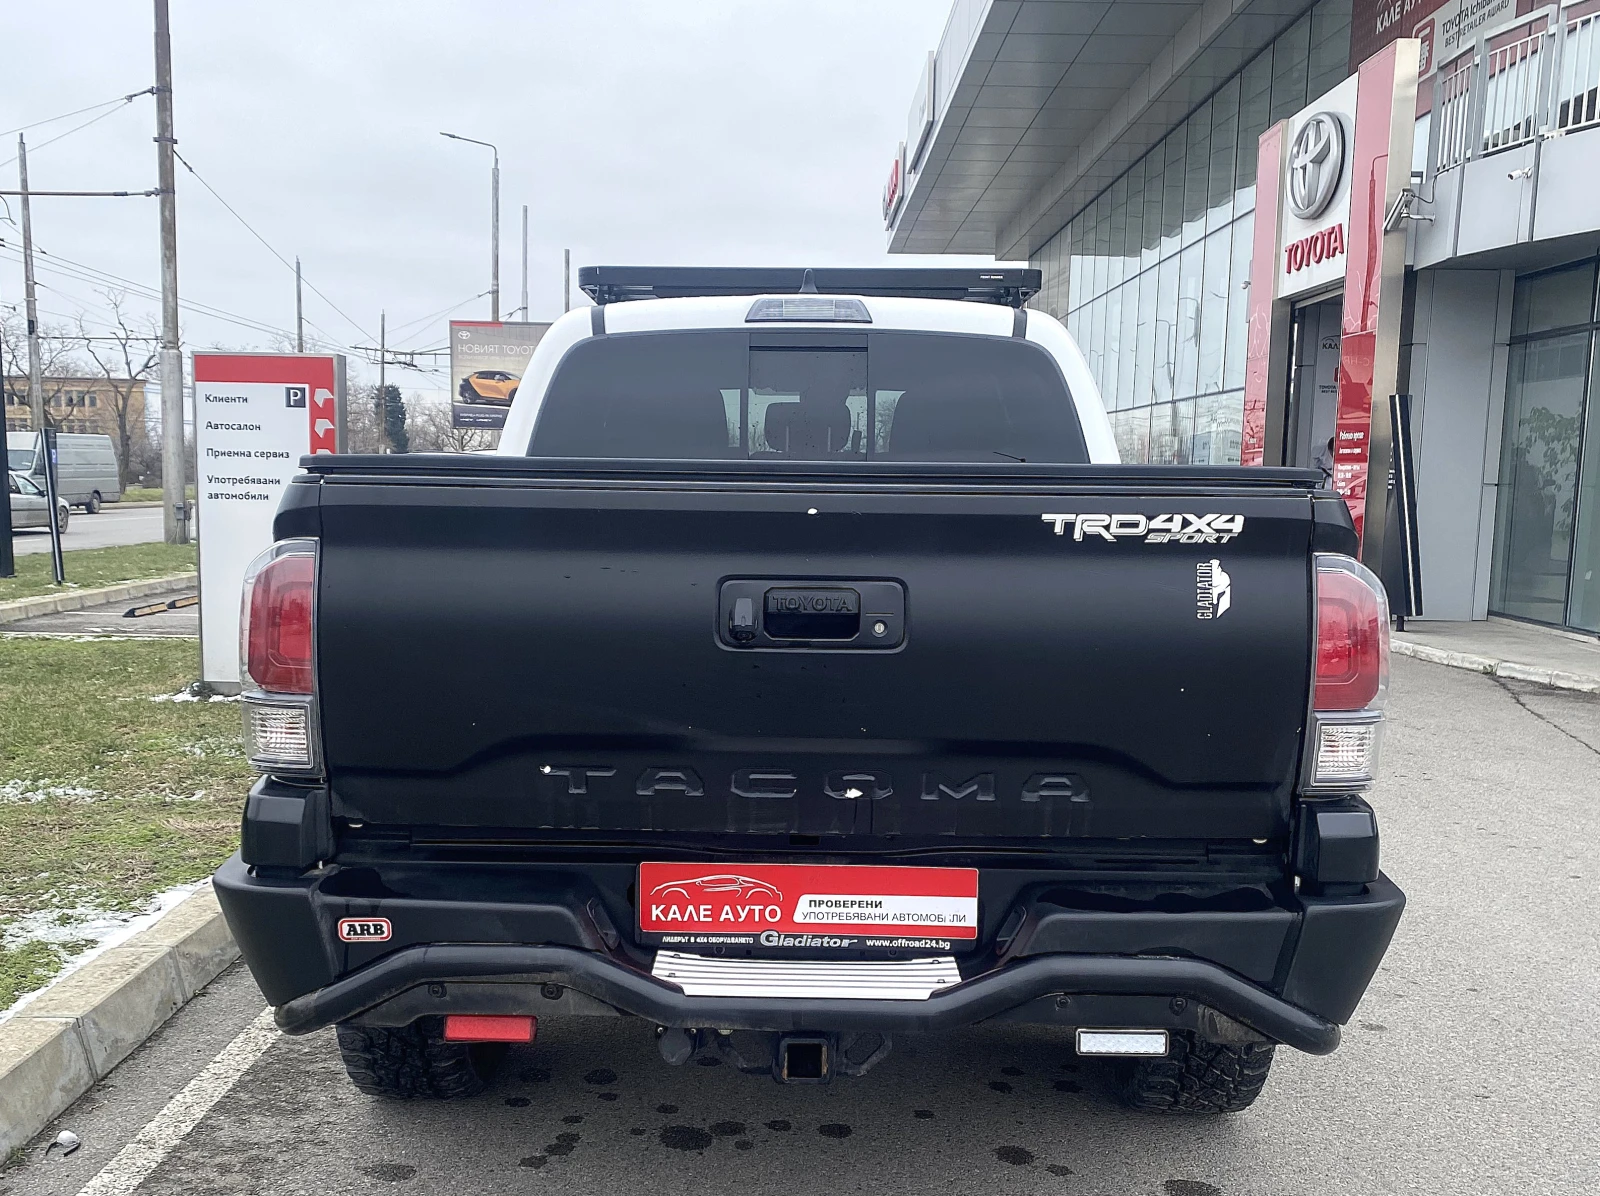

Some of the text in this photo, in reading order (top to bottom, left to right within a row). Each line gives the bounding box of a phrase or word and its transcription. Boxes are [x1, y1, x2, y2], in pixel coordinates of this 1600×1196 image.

[1442, 7, 1469, 36] TOYOTA
[1285, 223, 1344, 274] TOYOTA
[458, 343, 499, 353] НОВИЯТ
[204, 394, 248, 403] Клиенти
[289, 389, 301, 406] P
[205, 421, 261, 431] Автосалон
[206, 448, 290, 460] Приемна сервиз
[207, 475, 281, 486] Употребявани
[207, 491, 269, 500] автомобили
[1144, 532, 1239, 544] SPORT
[1196, 562, 1213, 619] GLADIATOR
[773, 595, 853, 612] TOYOTA
[543, 766, 1091, 803] TACOMA
[809, 900, 882, 909] ПРОВЕРЕНИ
[651, 904, 782, 923] КАЛЕ АУТО
[802, 911, 889, 922] УПОТРЕБЯВАНИ
[346, 923, 385, 937] ARB
[760, 930, 857, 947] Gladiator
[866, 938, 950, 949] www.offroad24.bg
